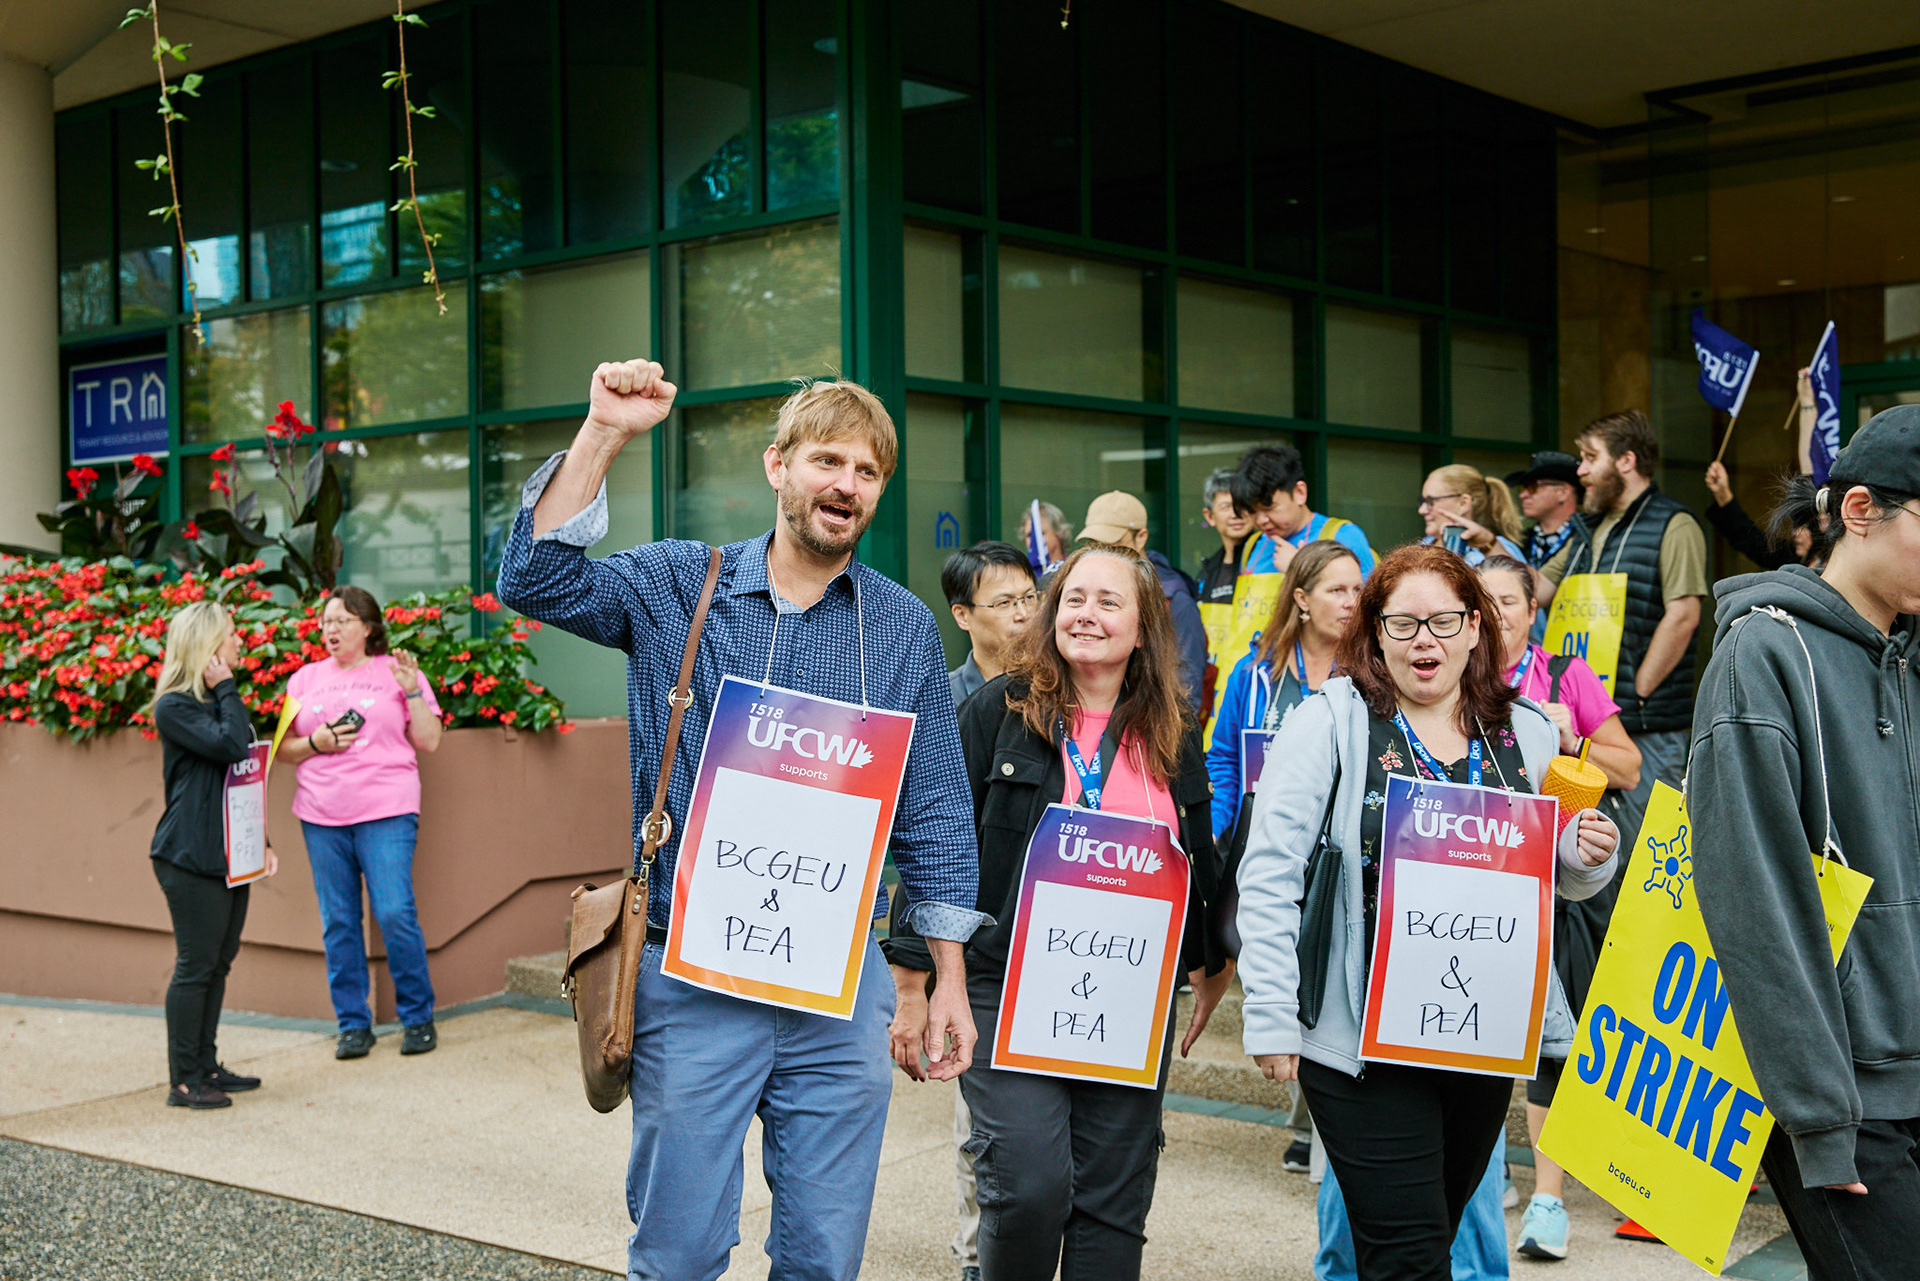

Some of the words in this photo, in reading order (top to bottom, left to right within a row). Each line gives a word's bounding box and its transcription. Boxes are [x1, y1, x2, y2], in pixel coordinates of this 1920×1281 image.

[750, 702, 785, 720] 1518
[747, 715, 859, 768] UFCW
[779, 761, 828, 781] supports
[1412, 797, 1443, 811] 1518
[1059, 822, 1088, 837] 1518
[1413, 808, 1510, 848] UFCW
[716, 839, 847, 893] BCGEU
[1058, 834, 1150, 874] UFCW
[1448, 849, 1492, 863] supports
[1086, 873, 1127, 887] supports
[760, 888, 780, 912] &
[724, 916, 795, 963] PEA
[1406, 911, 1517, 944] BCGEU
[1047, 927, 1147, 967] BCGEU
[1071, 971, 1098, 1000] &
[1440, 955, 1472, 998] &
[1652, 941, 1730, 1051] ON
[1052, 1010, 1106, 1042] PEA
[1420, 1002, 1480, 1041] PEA
[1577, 1004, 1765, 1183] STRIKE
[1607, 1162, 1651, 1199] bcgeu.ca
